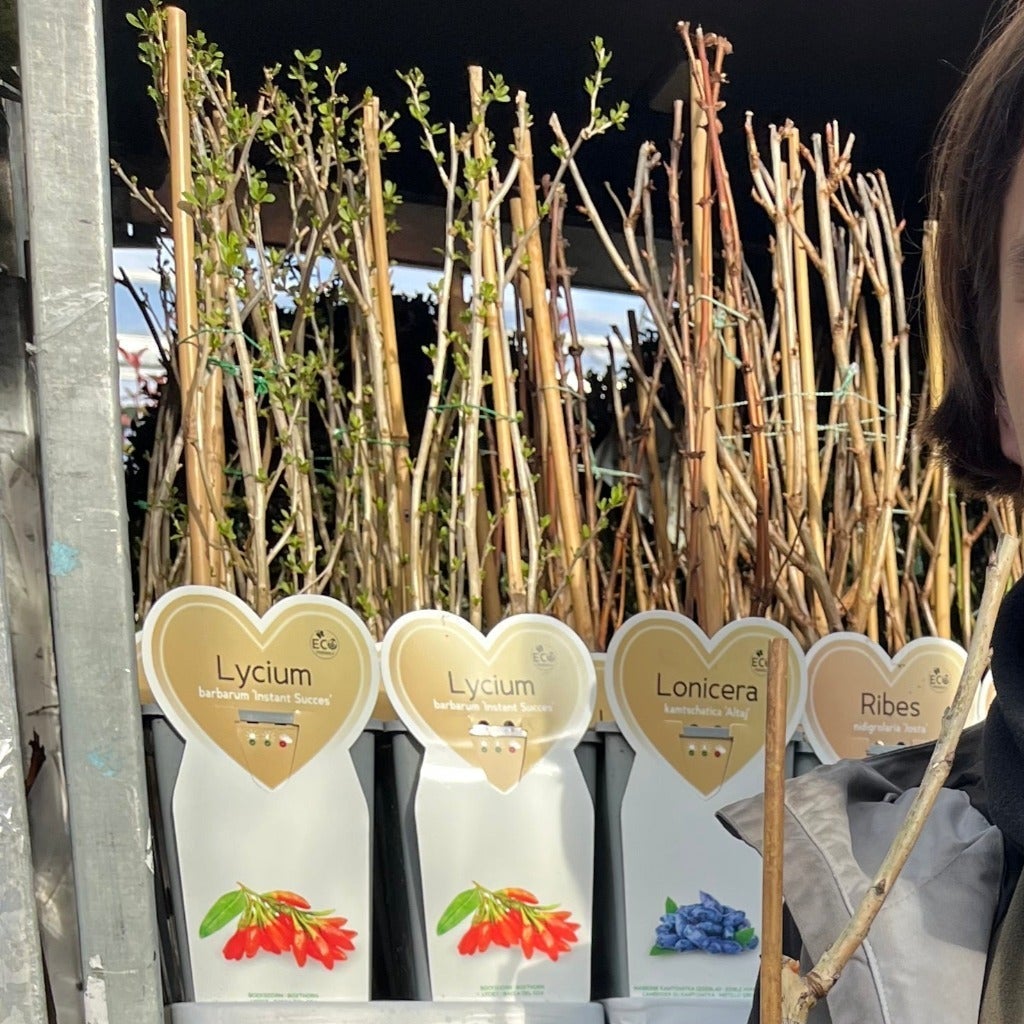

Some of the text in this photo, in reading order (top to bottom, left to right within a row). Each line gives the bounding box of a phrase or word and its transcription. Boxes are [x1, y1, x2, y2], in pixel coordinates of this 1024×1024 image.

[217, 655, 311, 689] Lycium
[448, 671, 535, 701] Lycium
[198, 686, 249, 701] barbarum
[657, 673, 758, 702] Lonicera
[861, 692, 920, 717] Ribes
